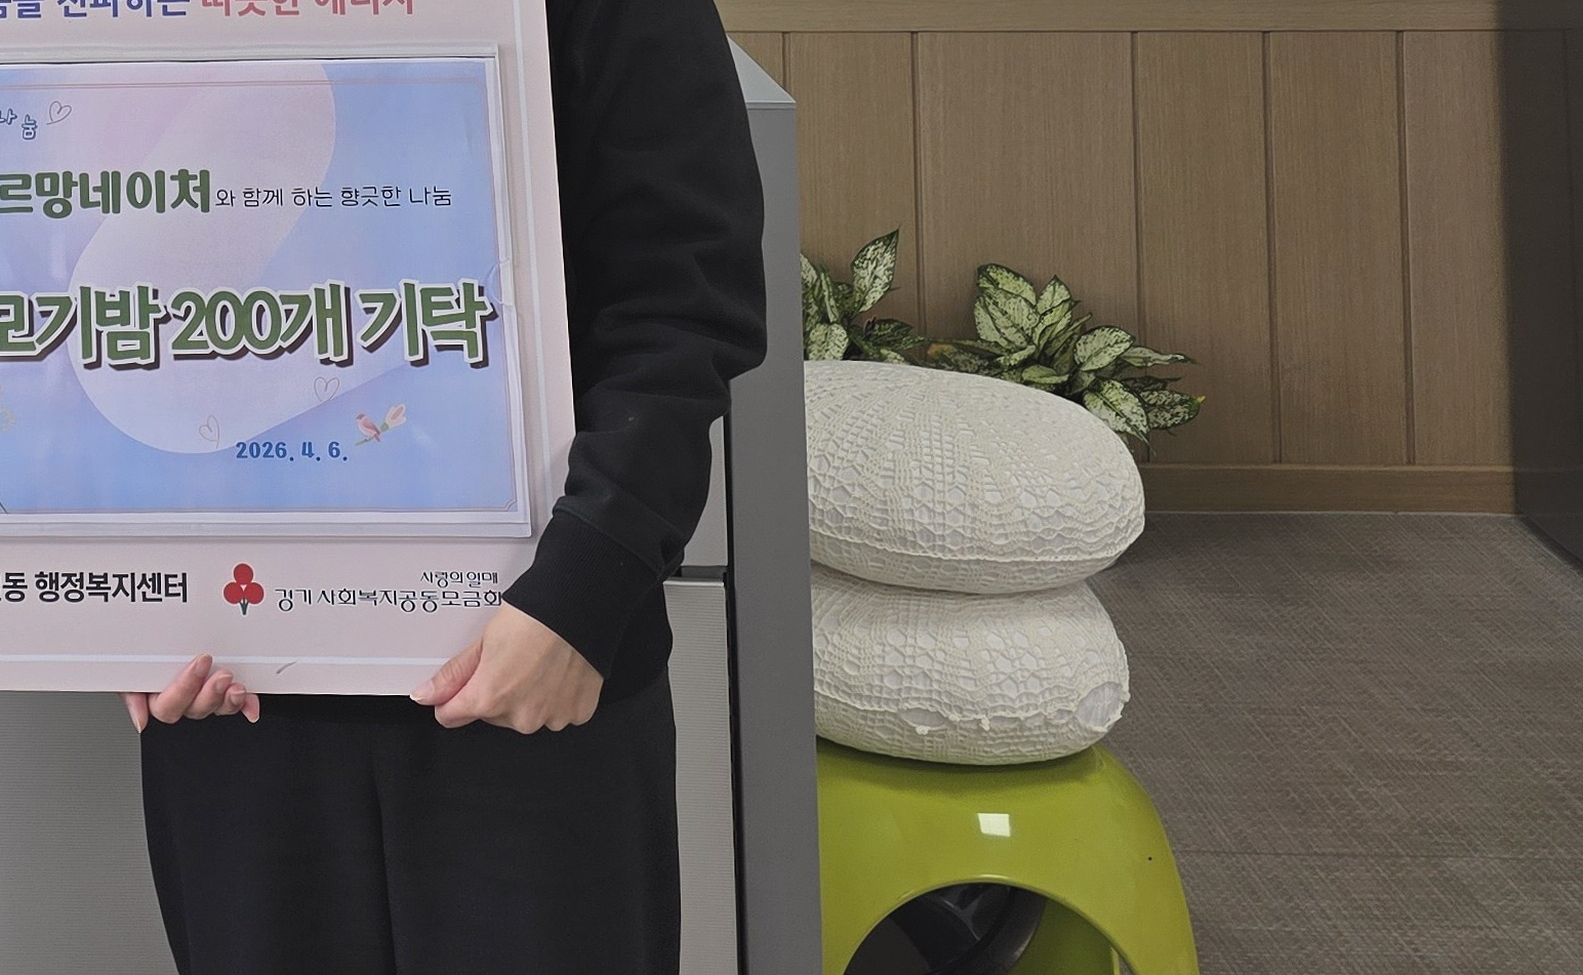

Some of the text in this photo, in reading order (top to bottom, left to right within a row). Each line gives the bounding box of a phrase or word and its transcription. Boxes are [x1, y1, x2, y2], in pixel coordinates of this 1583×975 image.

[242, 186, 284, 208] 함께
[291, 185, 333, 208] 하는
[340, 185, 402, 208] 향긋한
[409, 185, 452, 207] 나눔
[169, 280, 355, 366] 200개
[356, 280, 496, 368] 기탁
[235, 441, 348, 462] 2026. 4. 6.
[34, 570, 188, 603] 행정복지센터
